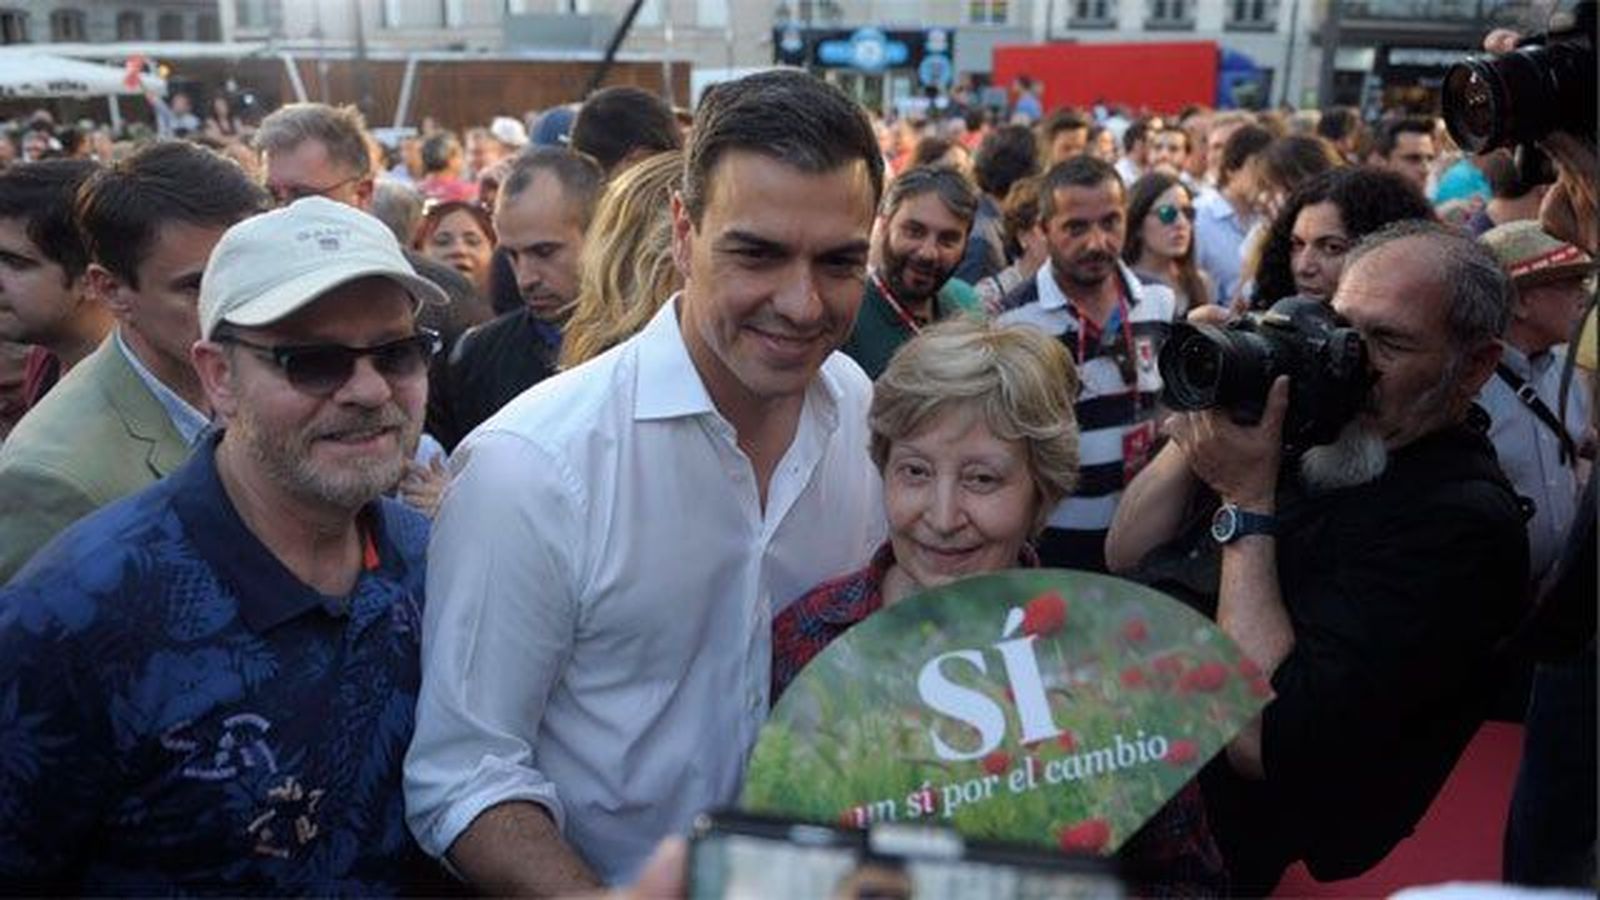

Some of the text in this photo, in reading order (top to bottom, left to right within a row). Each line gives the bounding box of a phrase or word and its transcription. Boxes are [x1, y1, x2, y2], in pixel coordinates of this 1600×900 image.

[917, 606, 1062, 761] SÍ
[907, 780, 935, 818] sí
[942, 772, 999, 818] por
[1008, 756, 1038, 793] el
[1044, 729, 1169, 784] cambio
